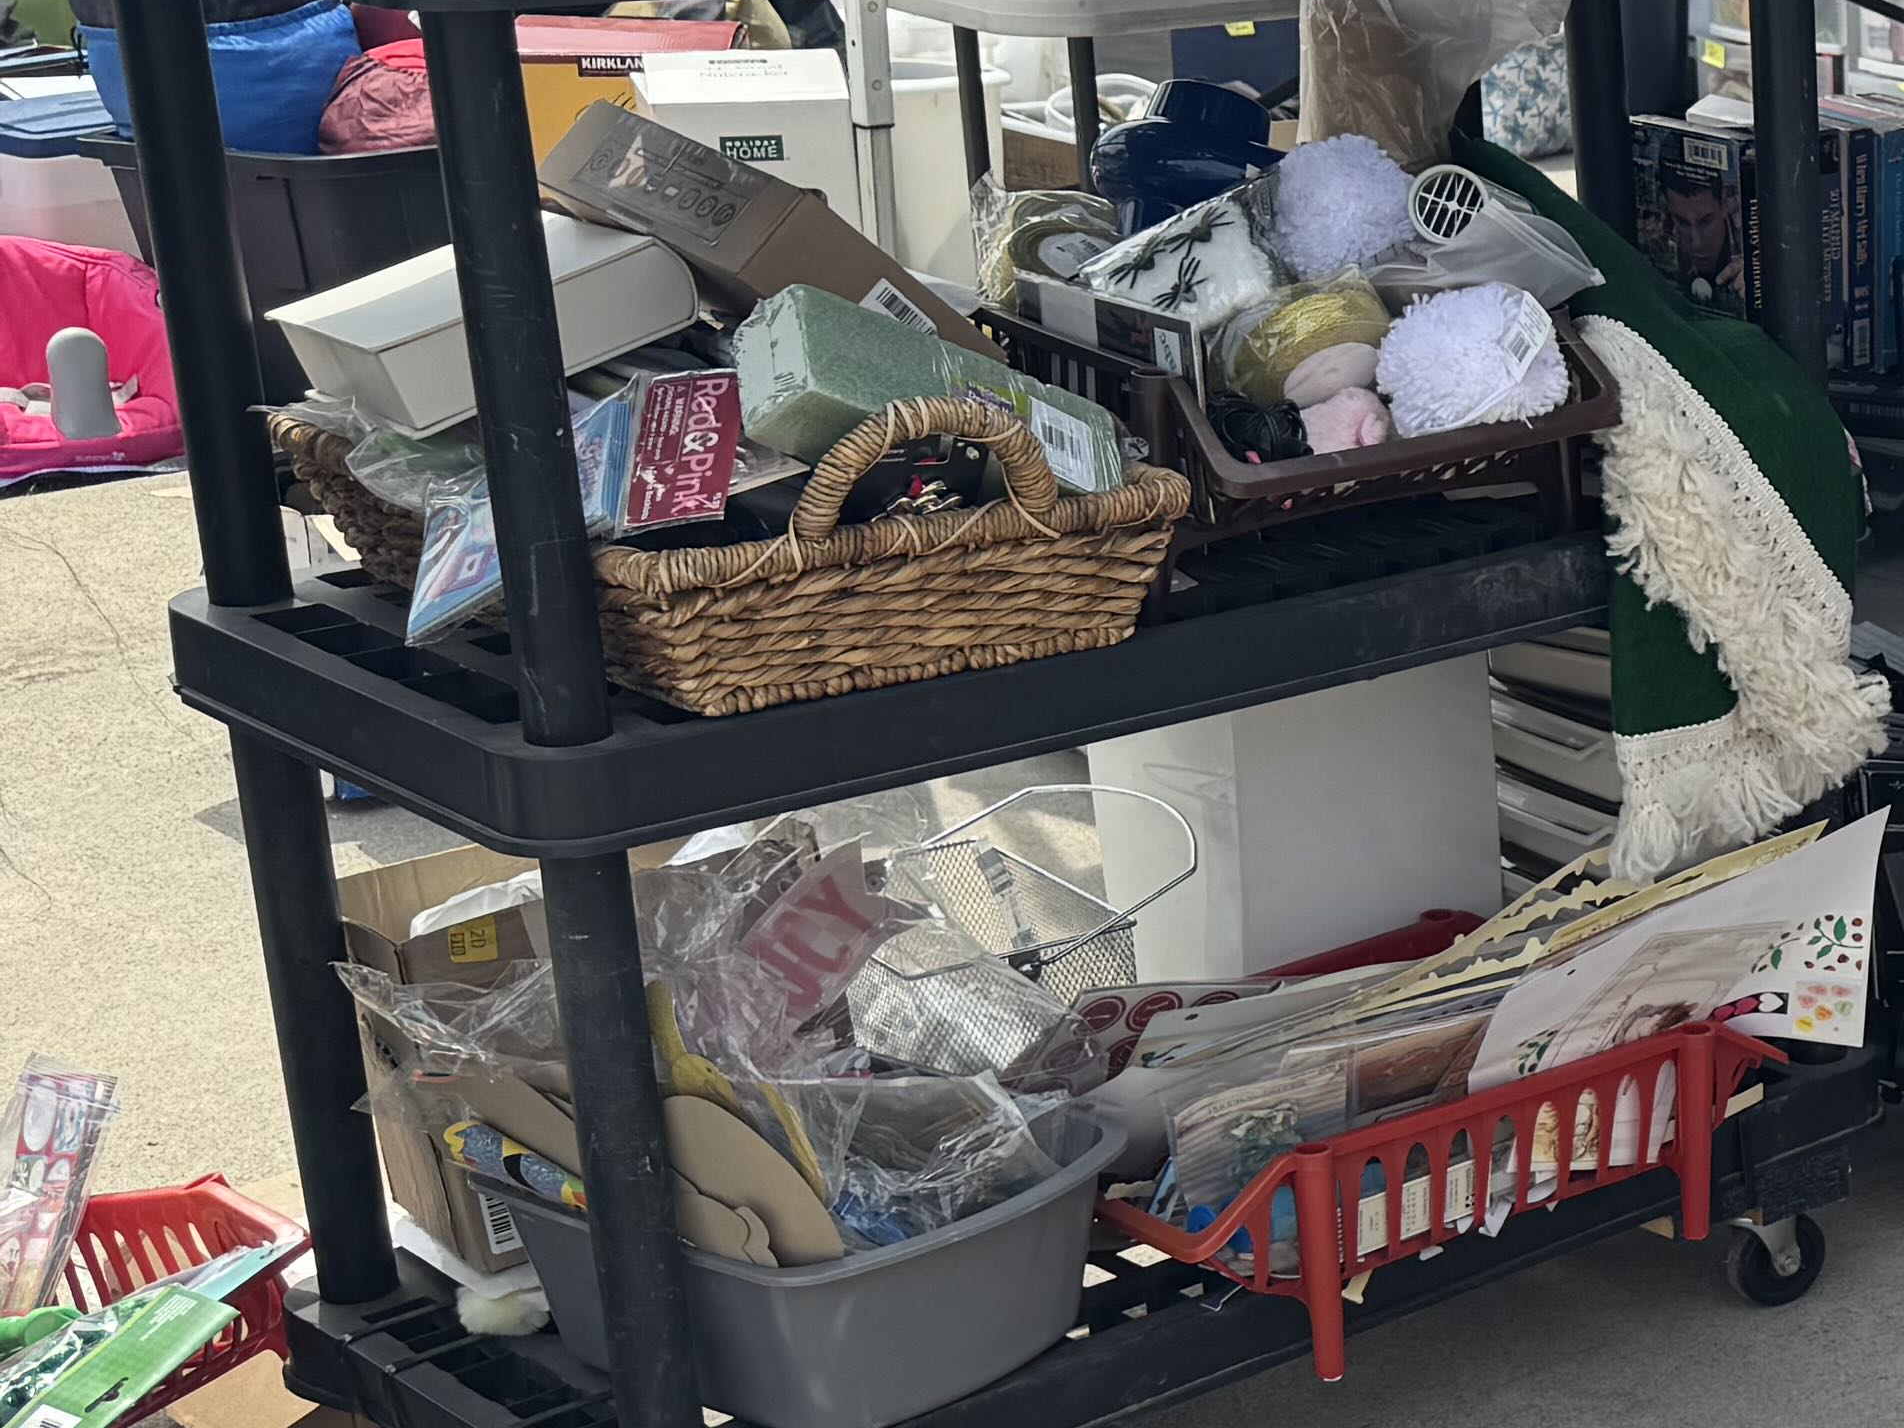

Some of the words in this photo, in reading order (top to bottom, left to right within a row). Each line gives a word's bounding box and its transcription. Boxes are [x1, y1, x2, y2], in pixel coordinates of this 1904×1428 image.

[581, 56, 644, 70] KIRKLAN
[726, 146, 778, 161] HOME
[1854, 188, 1868, 218] Harry
[1748, 197, 1760, 249] Happy
[1750, 250, 1763, 310] Gilmore
